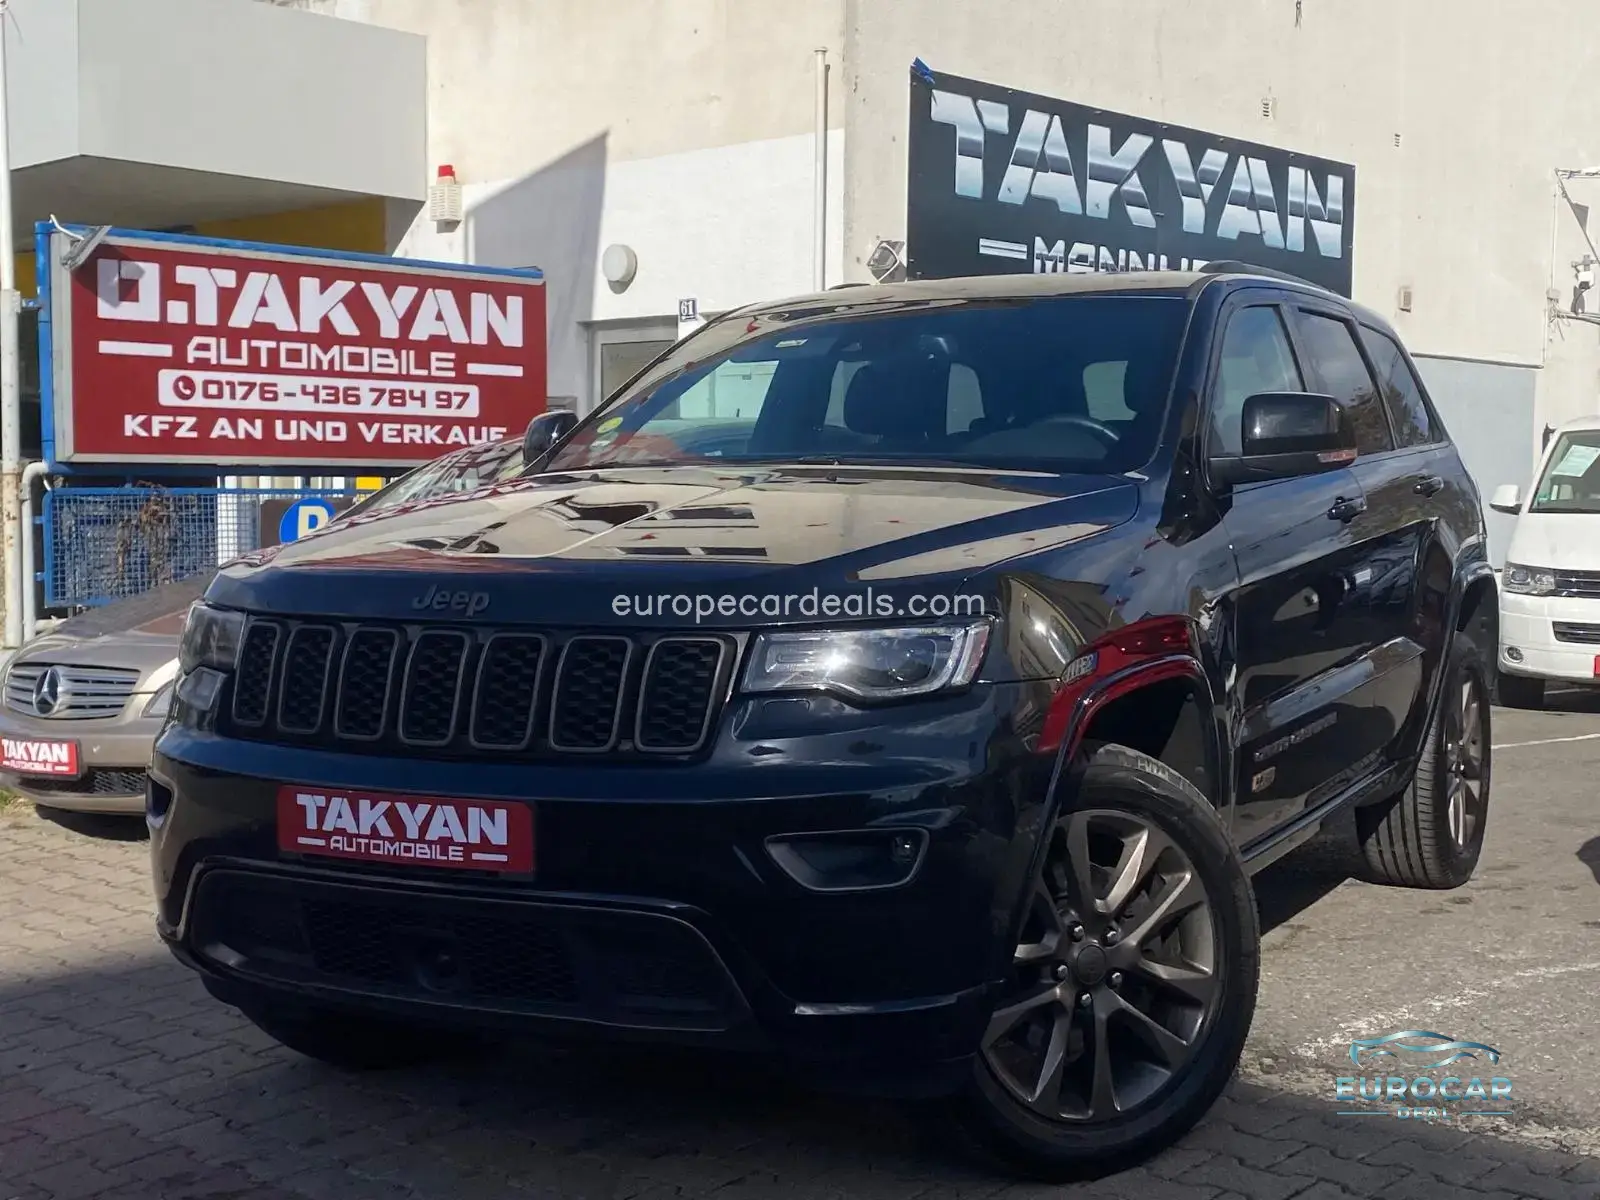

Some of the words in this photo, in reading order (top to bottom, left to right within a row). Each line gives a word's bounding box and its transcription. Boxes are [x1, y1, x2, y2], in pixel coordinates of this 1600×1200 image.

[931, 89, 1343, 258] TAKYAN
[680, 300, 693, 316] 61
[187, 336, 456, 377] AUTOMOBILE
[369, 388, 427, 408] 784
[435, 391, 470, 410] 97
[123, 414, 198, 438] KFZ
[209, 418, 262, 439] AN
[275, 420, 347, 442] UND
[412, 583, 490, 617] Jeep
[2, 739, 69, 763] TAKYAN
[297, 794, 507, 845] TAKYAN
[330, 836, 464, 862] AUTOMOBILE
